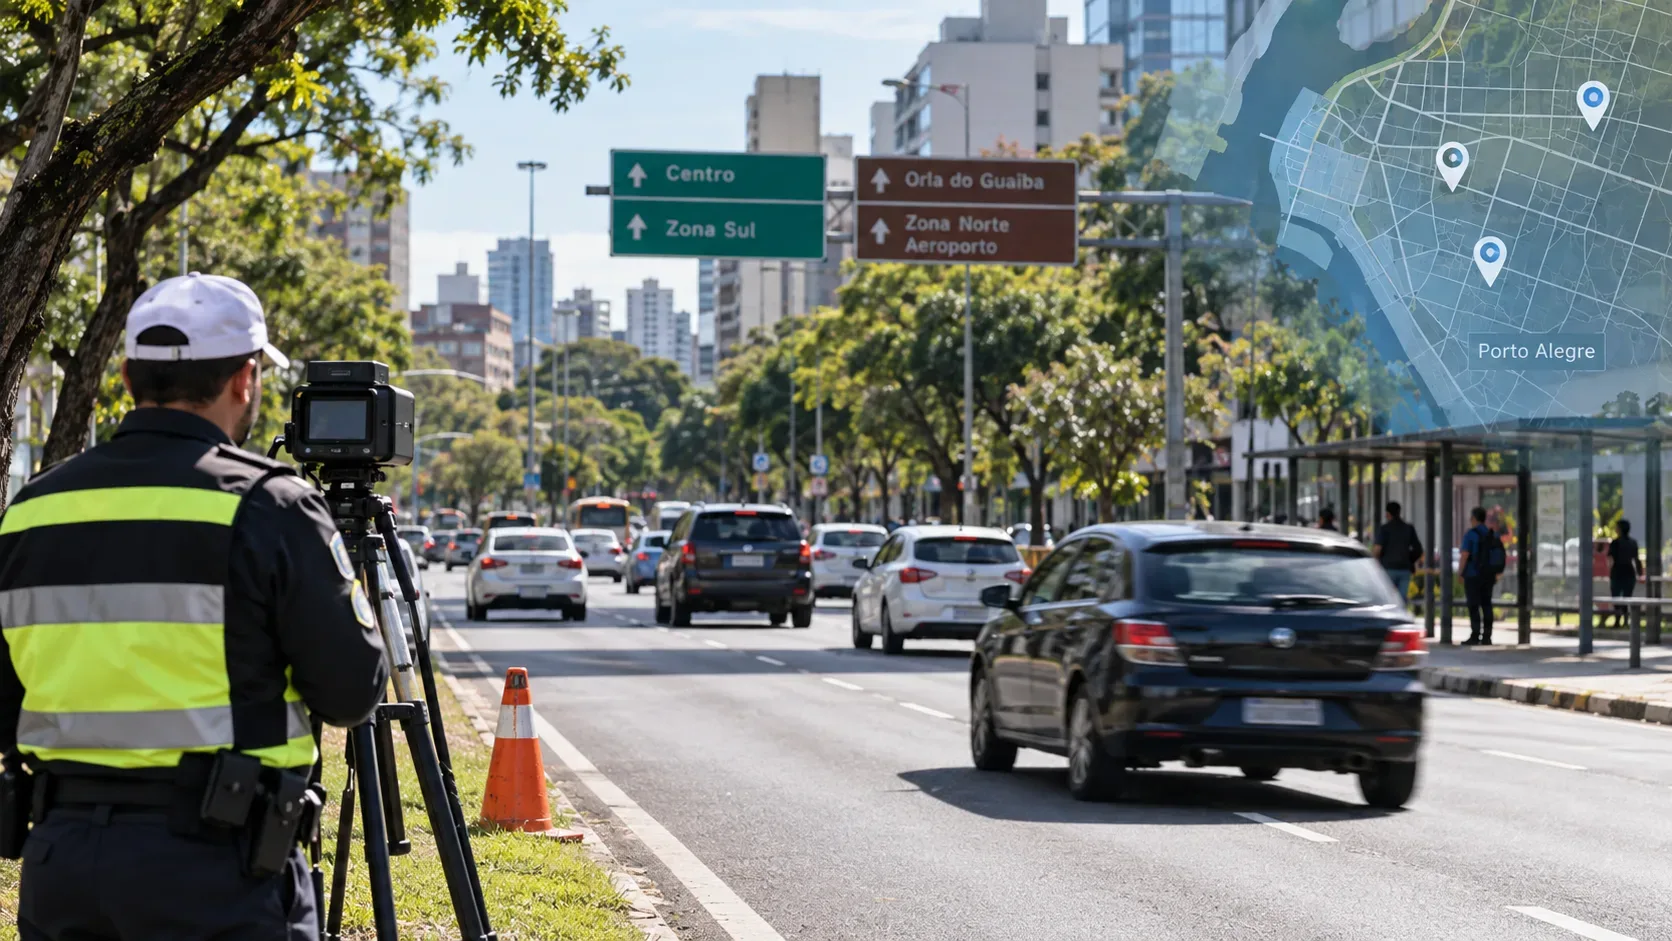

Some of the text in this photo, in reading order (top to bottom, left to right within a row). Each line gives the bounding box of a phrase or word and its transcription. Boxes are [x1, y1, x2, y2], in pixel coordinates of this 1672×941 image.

[666, 164, 735, 183] Centro
[904, 170, 944, 188] Orla
[949, 171, 974, 189] do
[665, 219, 756, 239] Zona Sul
[904, 214, 1010, 234] Zona Norte
[904, 237, 998, 257] Aeroporto
